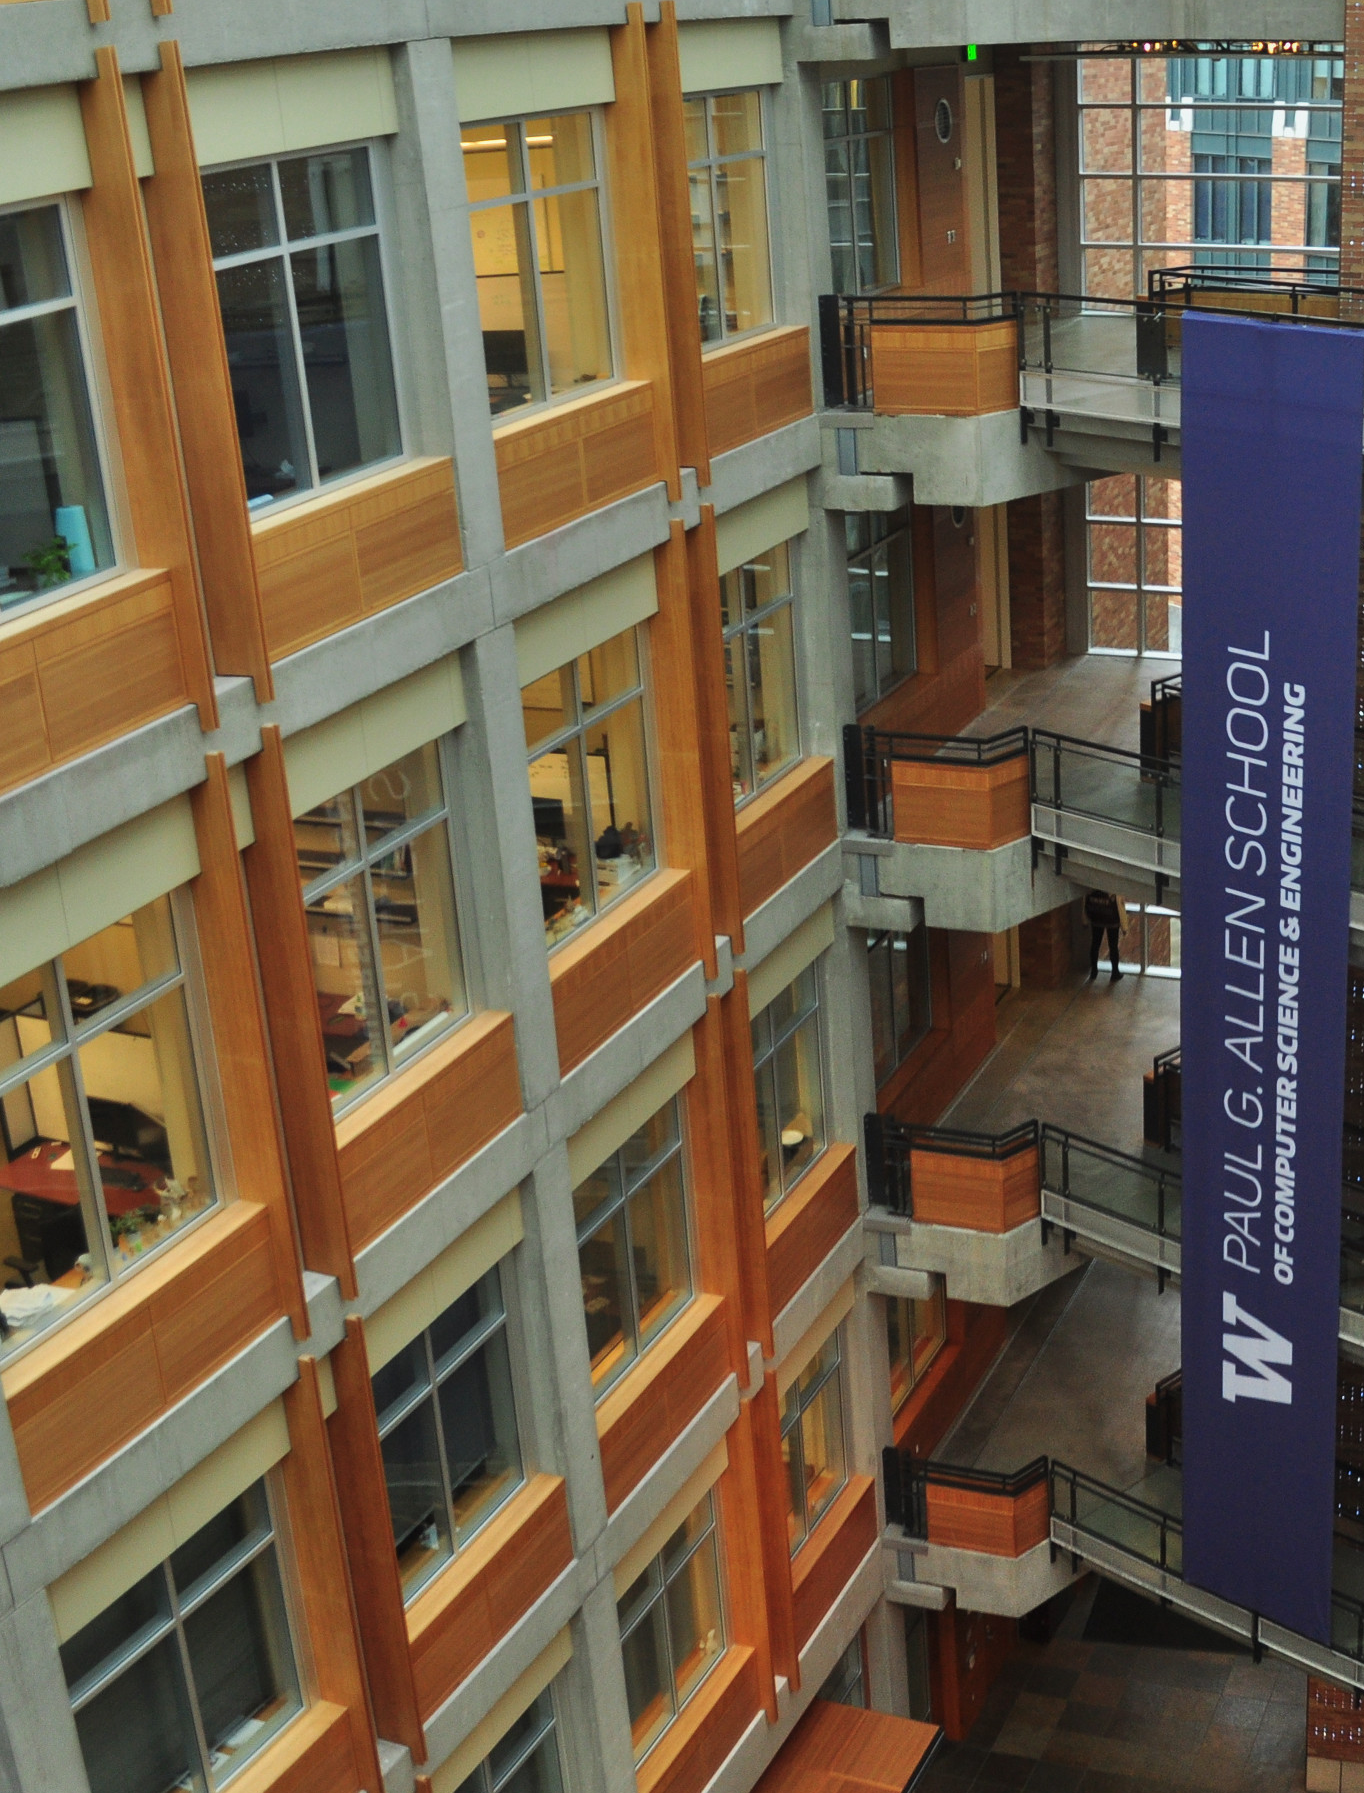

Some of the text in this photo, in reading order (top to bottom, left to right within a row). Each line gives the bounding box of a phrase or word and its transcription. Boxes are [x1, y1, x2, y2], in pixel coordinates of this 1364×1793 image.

[1223, 630, 1270, 1274] PAUL G. ALLEN SCHOOL
[1273, 682, 1306, 1285] OF COMPUTER SCIENCE & ENGINEERING
[1222, 1290, 1293, 1405] W
